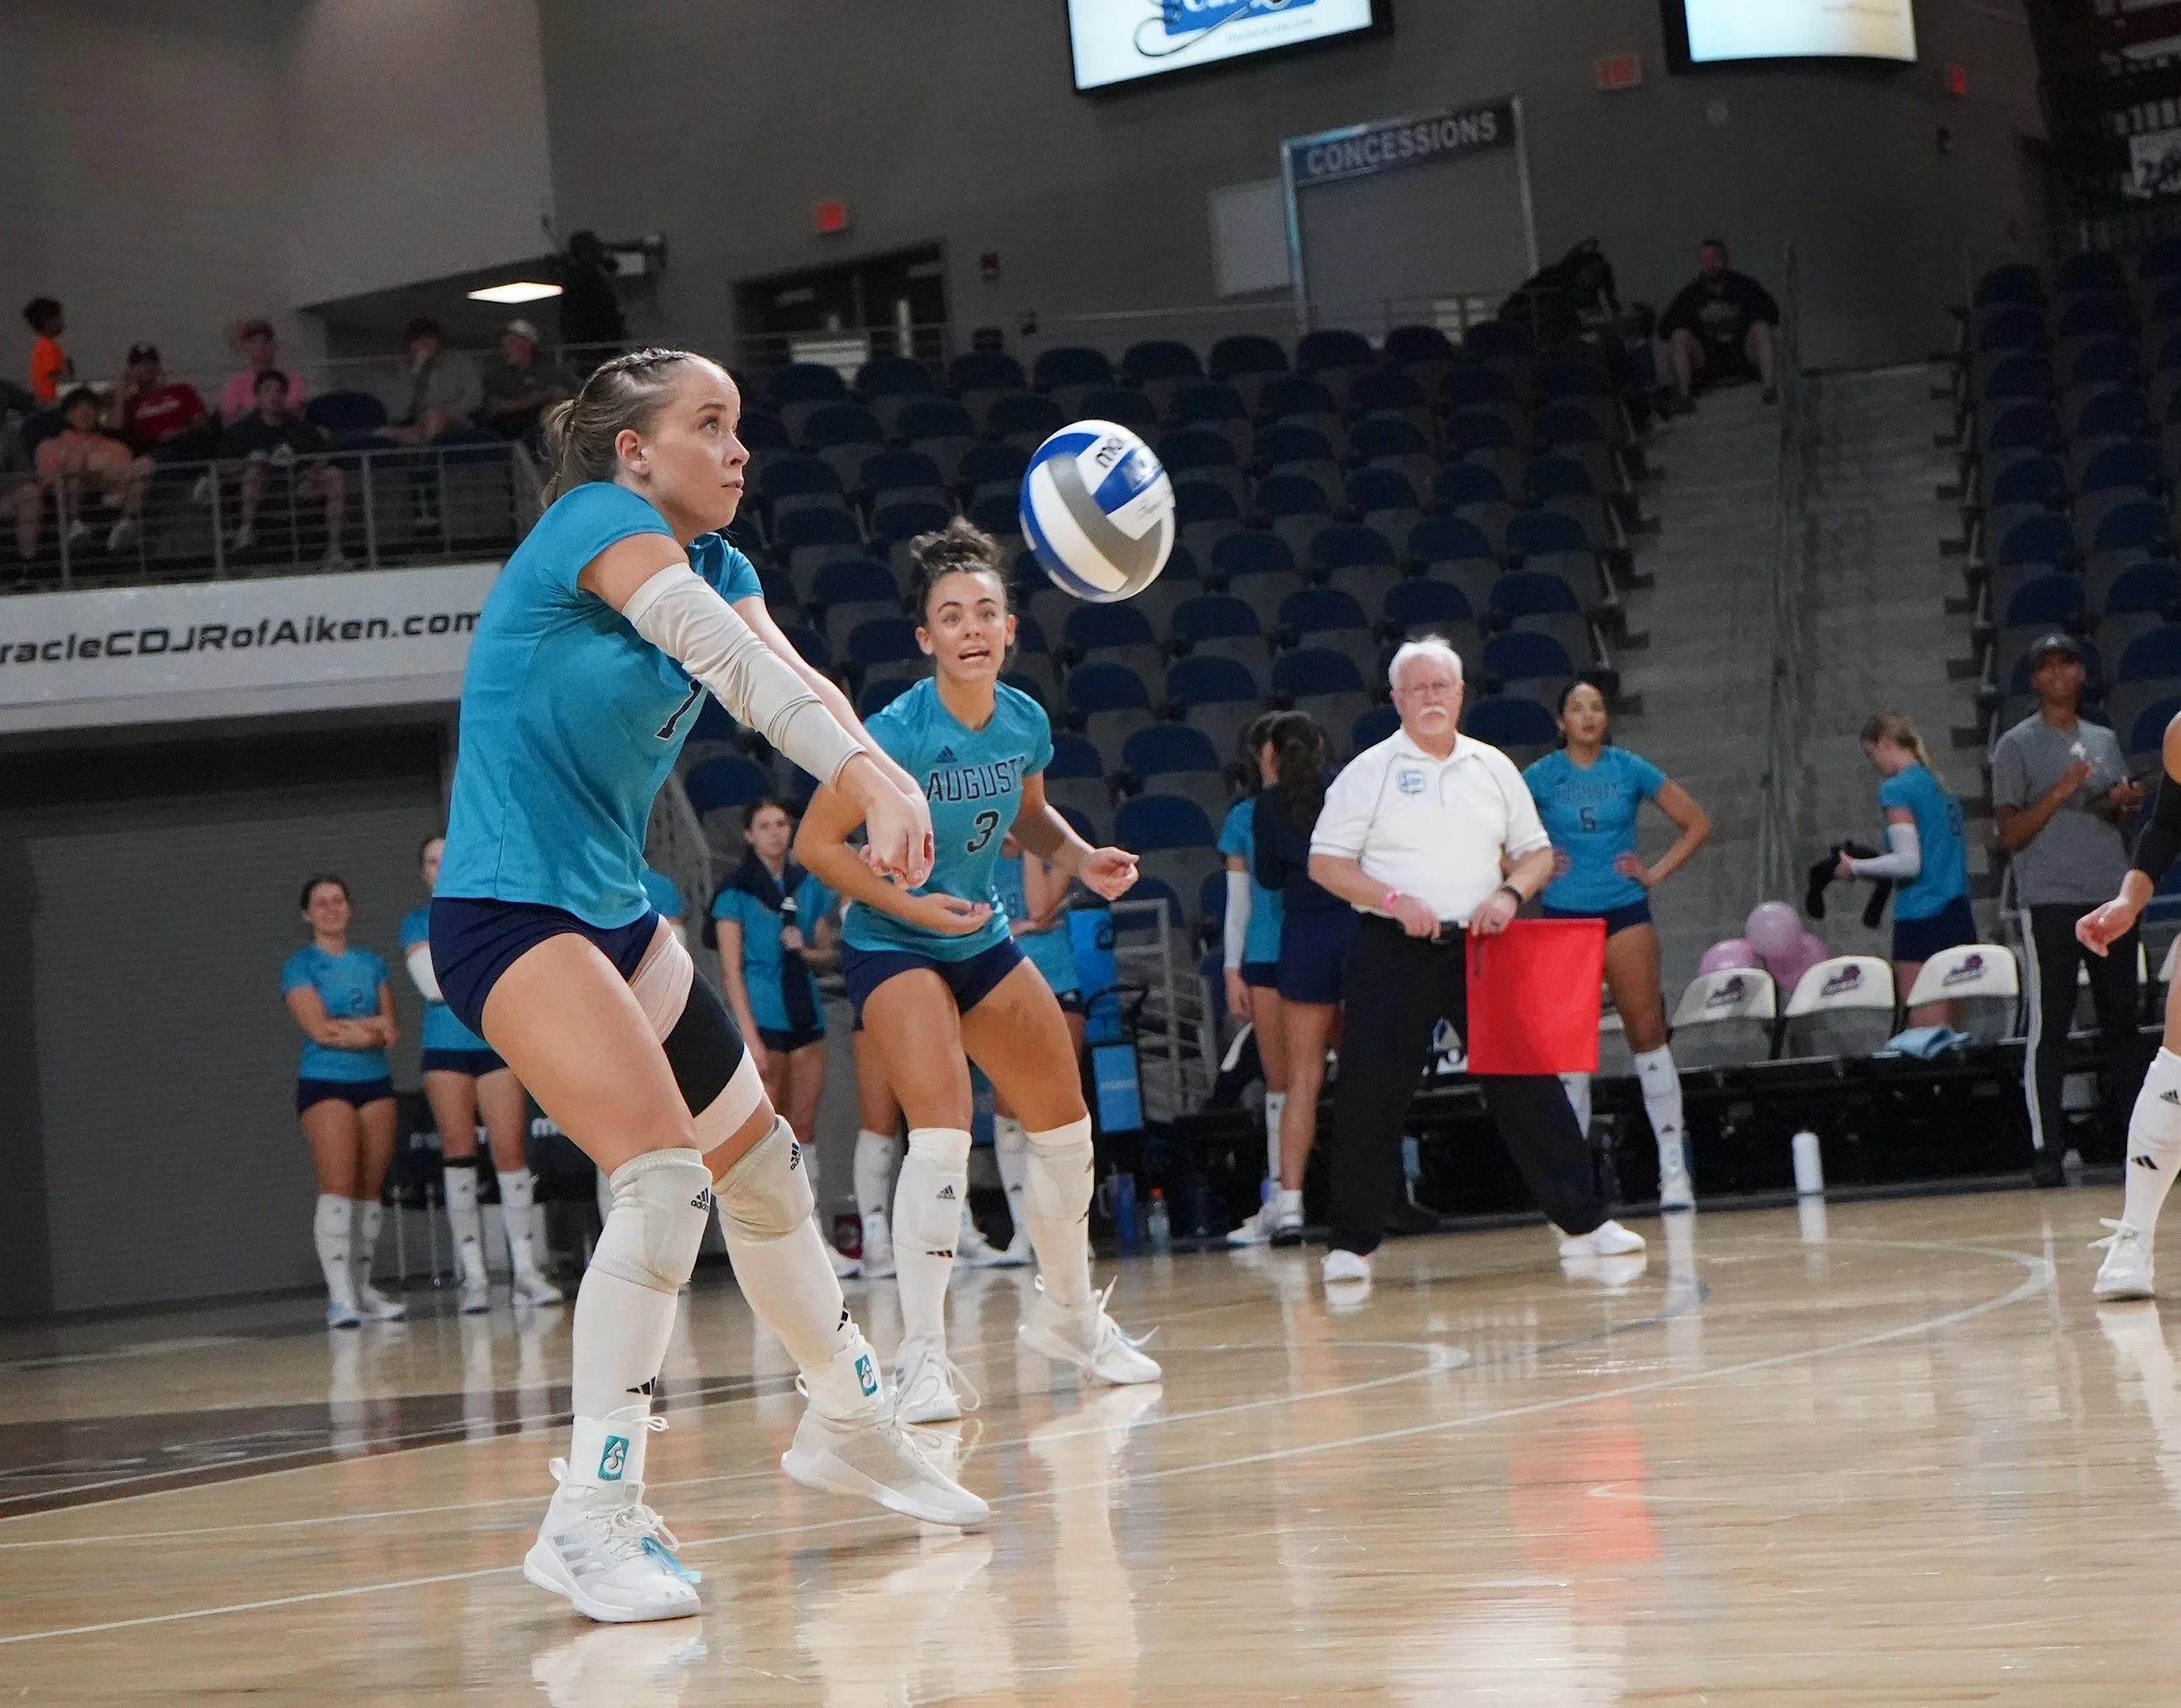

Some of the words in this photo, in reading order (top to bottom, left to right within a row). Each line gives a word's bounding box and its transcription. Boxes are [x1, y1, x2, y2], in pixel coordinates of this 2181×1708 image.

[1307, 109, 1498, 175] CONCESSIONS
[926, 755, 1024, 802] AUGUST
[966, 810, 1000, 853] 3
